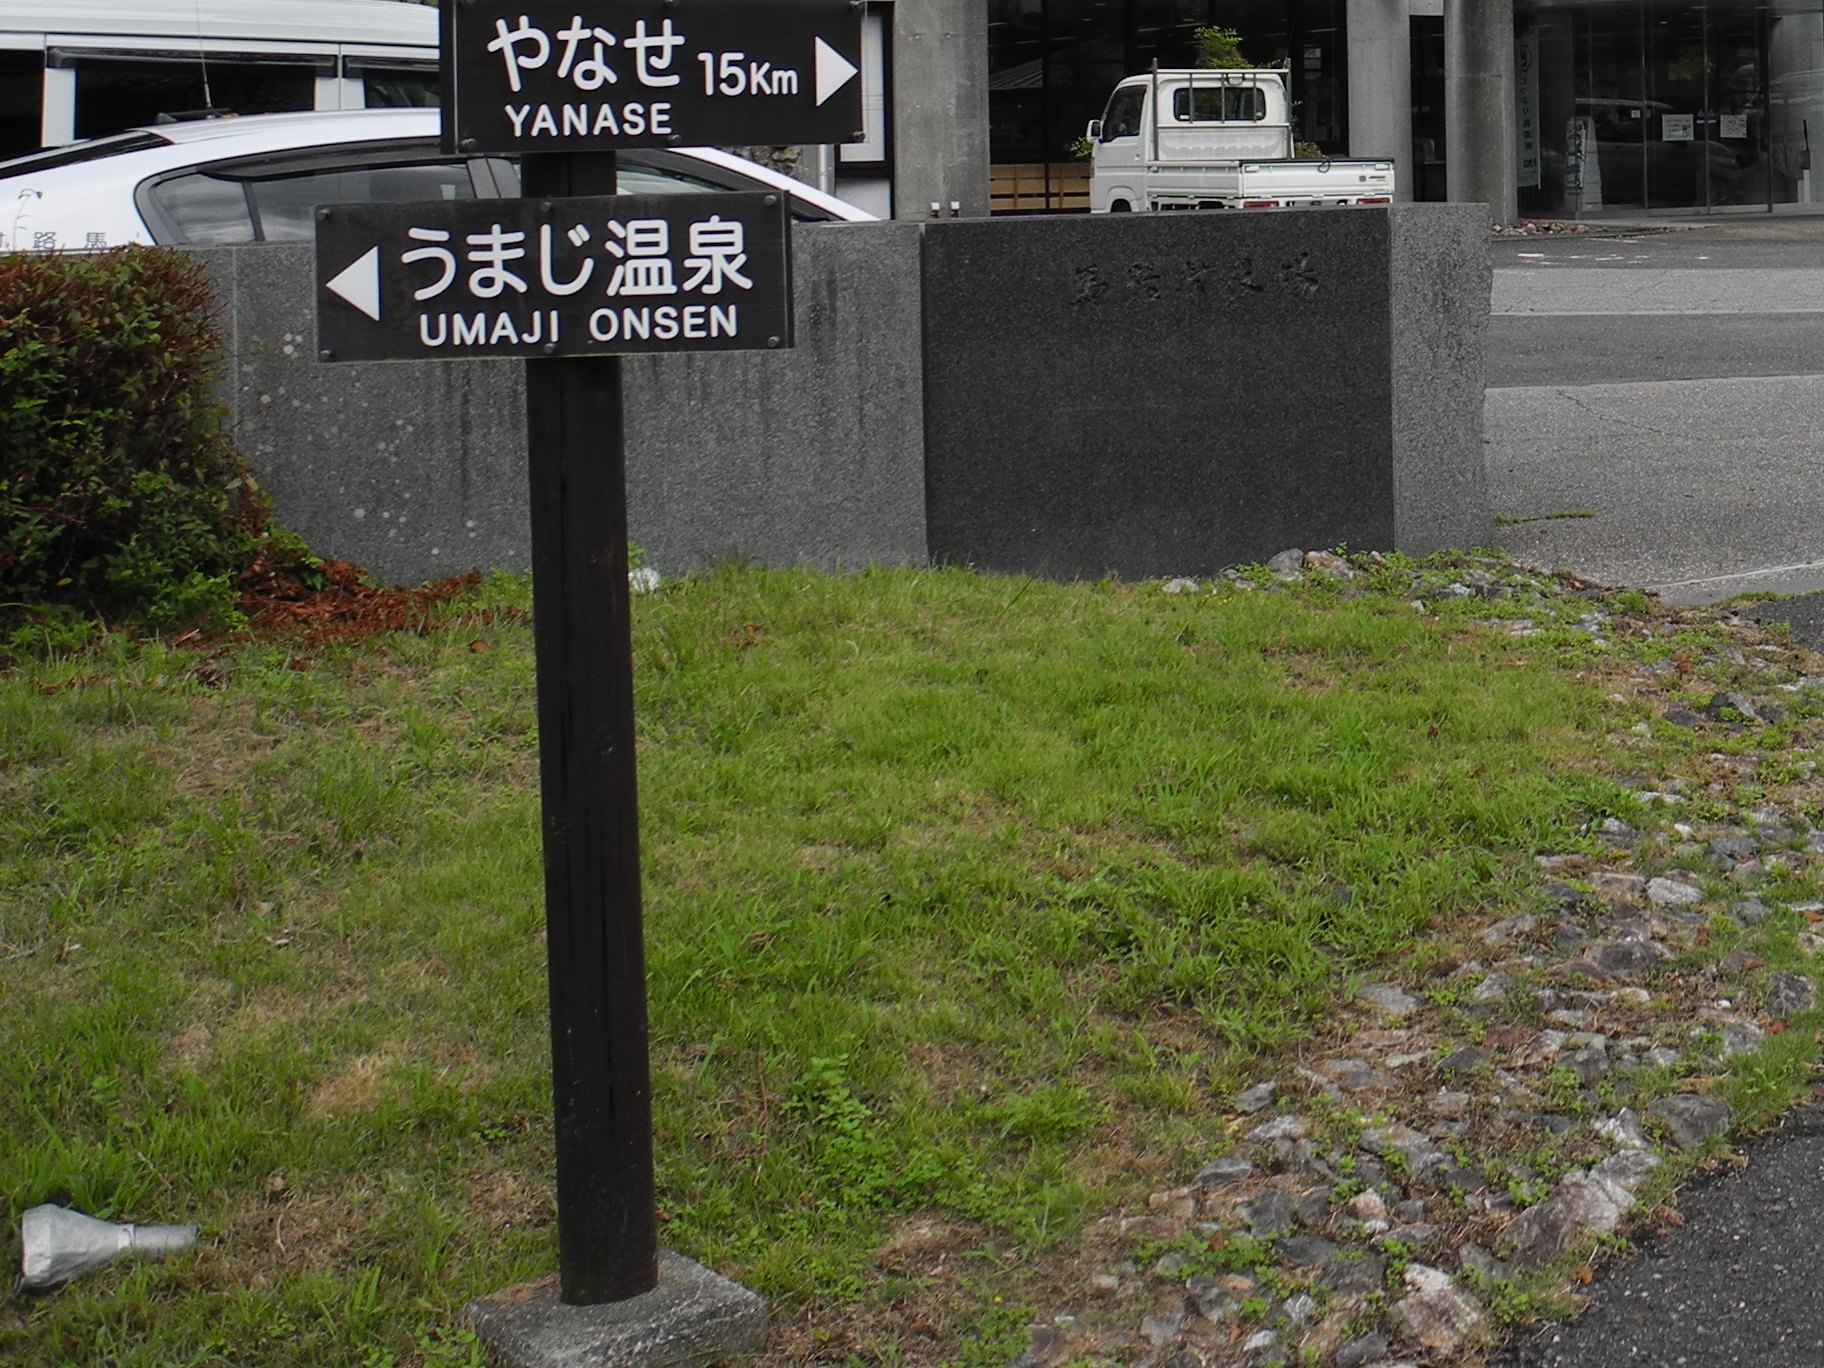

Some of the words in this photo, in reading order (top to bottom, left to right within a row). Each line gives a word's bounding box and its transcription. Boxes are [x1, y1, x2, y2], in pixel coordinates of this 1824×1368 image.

[486, 14, 686, 93] やなせ
[697, 51, 799, 97] 15Km
[503, 101, 673, 138] YANASE
[401, 214, 754, 302] うまじ温泉
[419, 309, 560, 347] UMAJI
[588, 303, 739, 343] ONSEN
